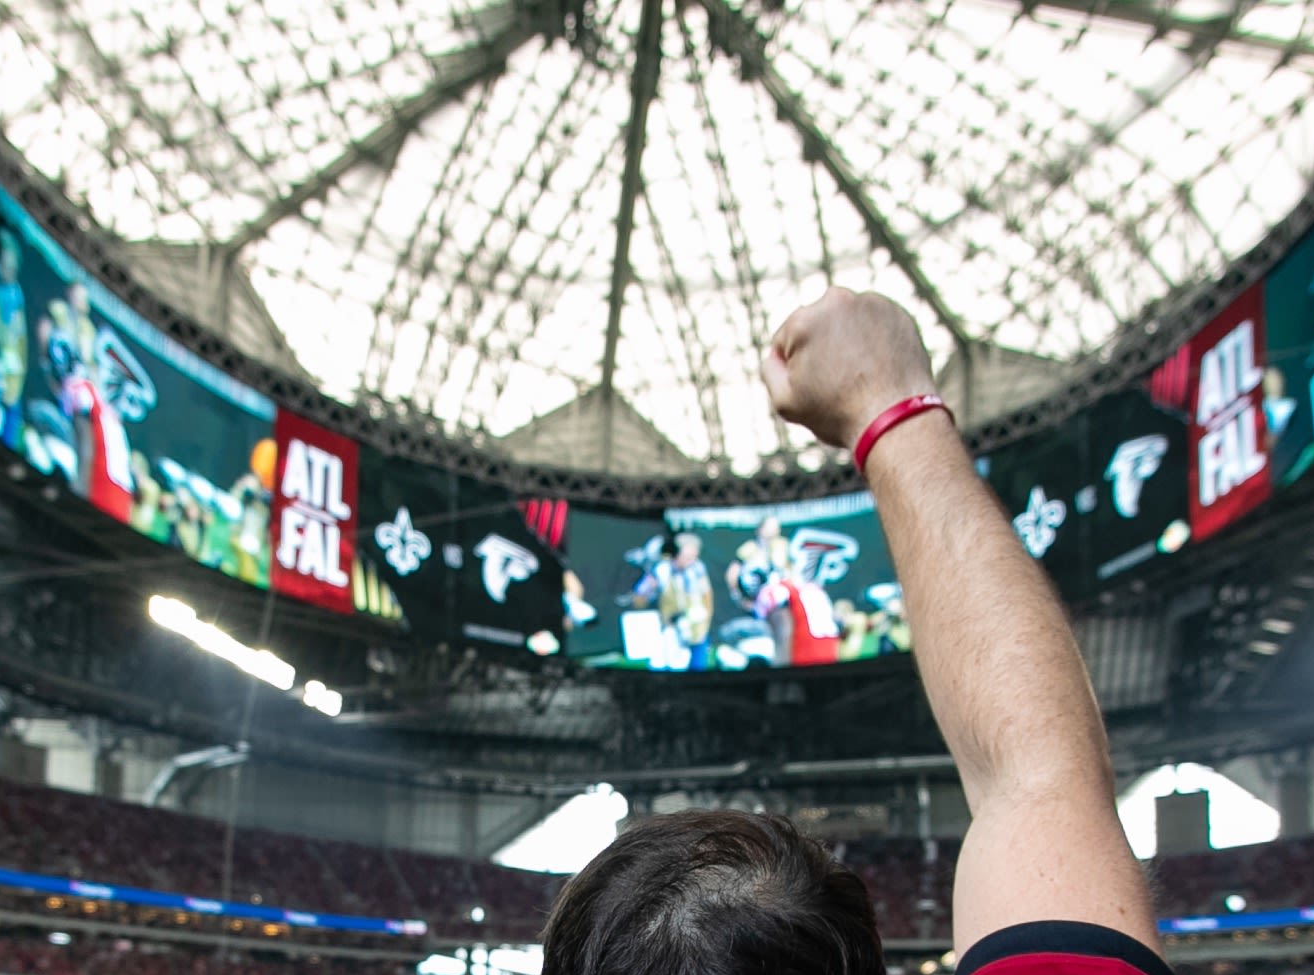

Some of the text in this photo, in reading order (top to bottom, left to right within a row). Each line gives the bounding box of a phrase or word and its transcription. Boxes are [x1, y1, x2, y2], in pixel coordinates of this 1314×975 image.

[1197, 320, 1264, 426] ATL
[282, 438, 351, 520] ATL
[1198, 404, 1266, 506] FAL
[276, 507, 349, 587] FAL
